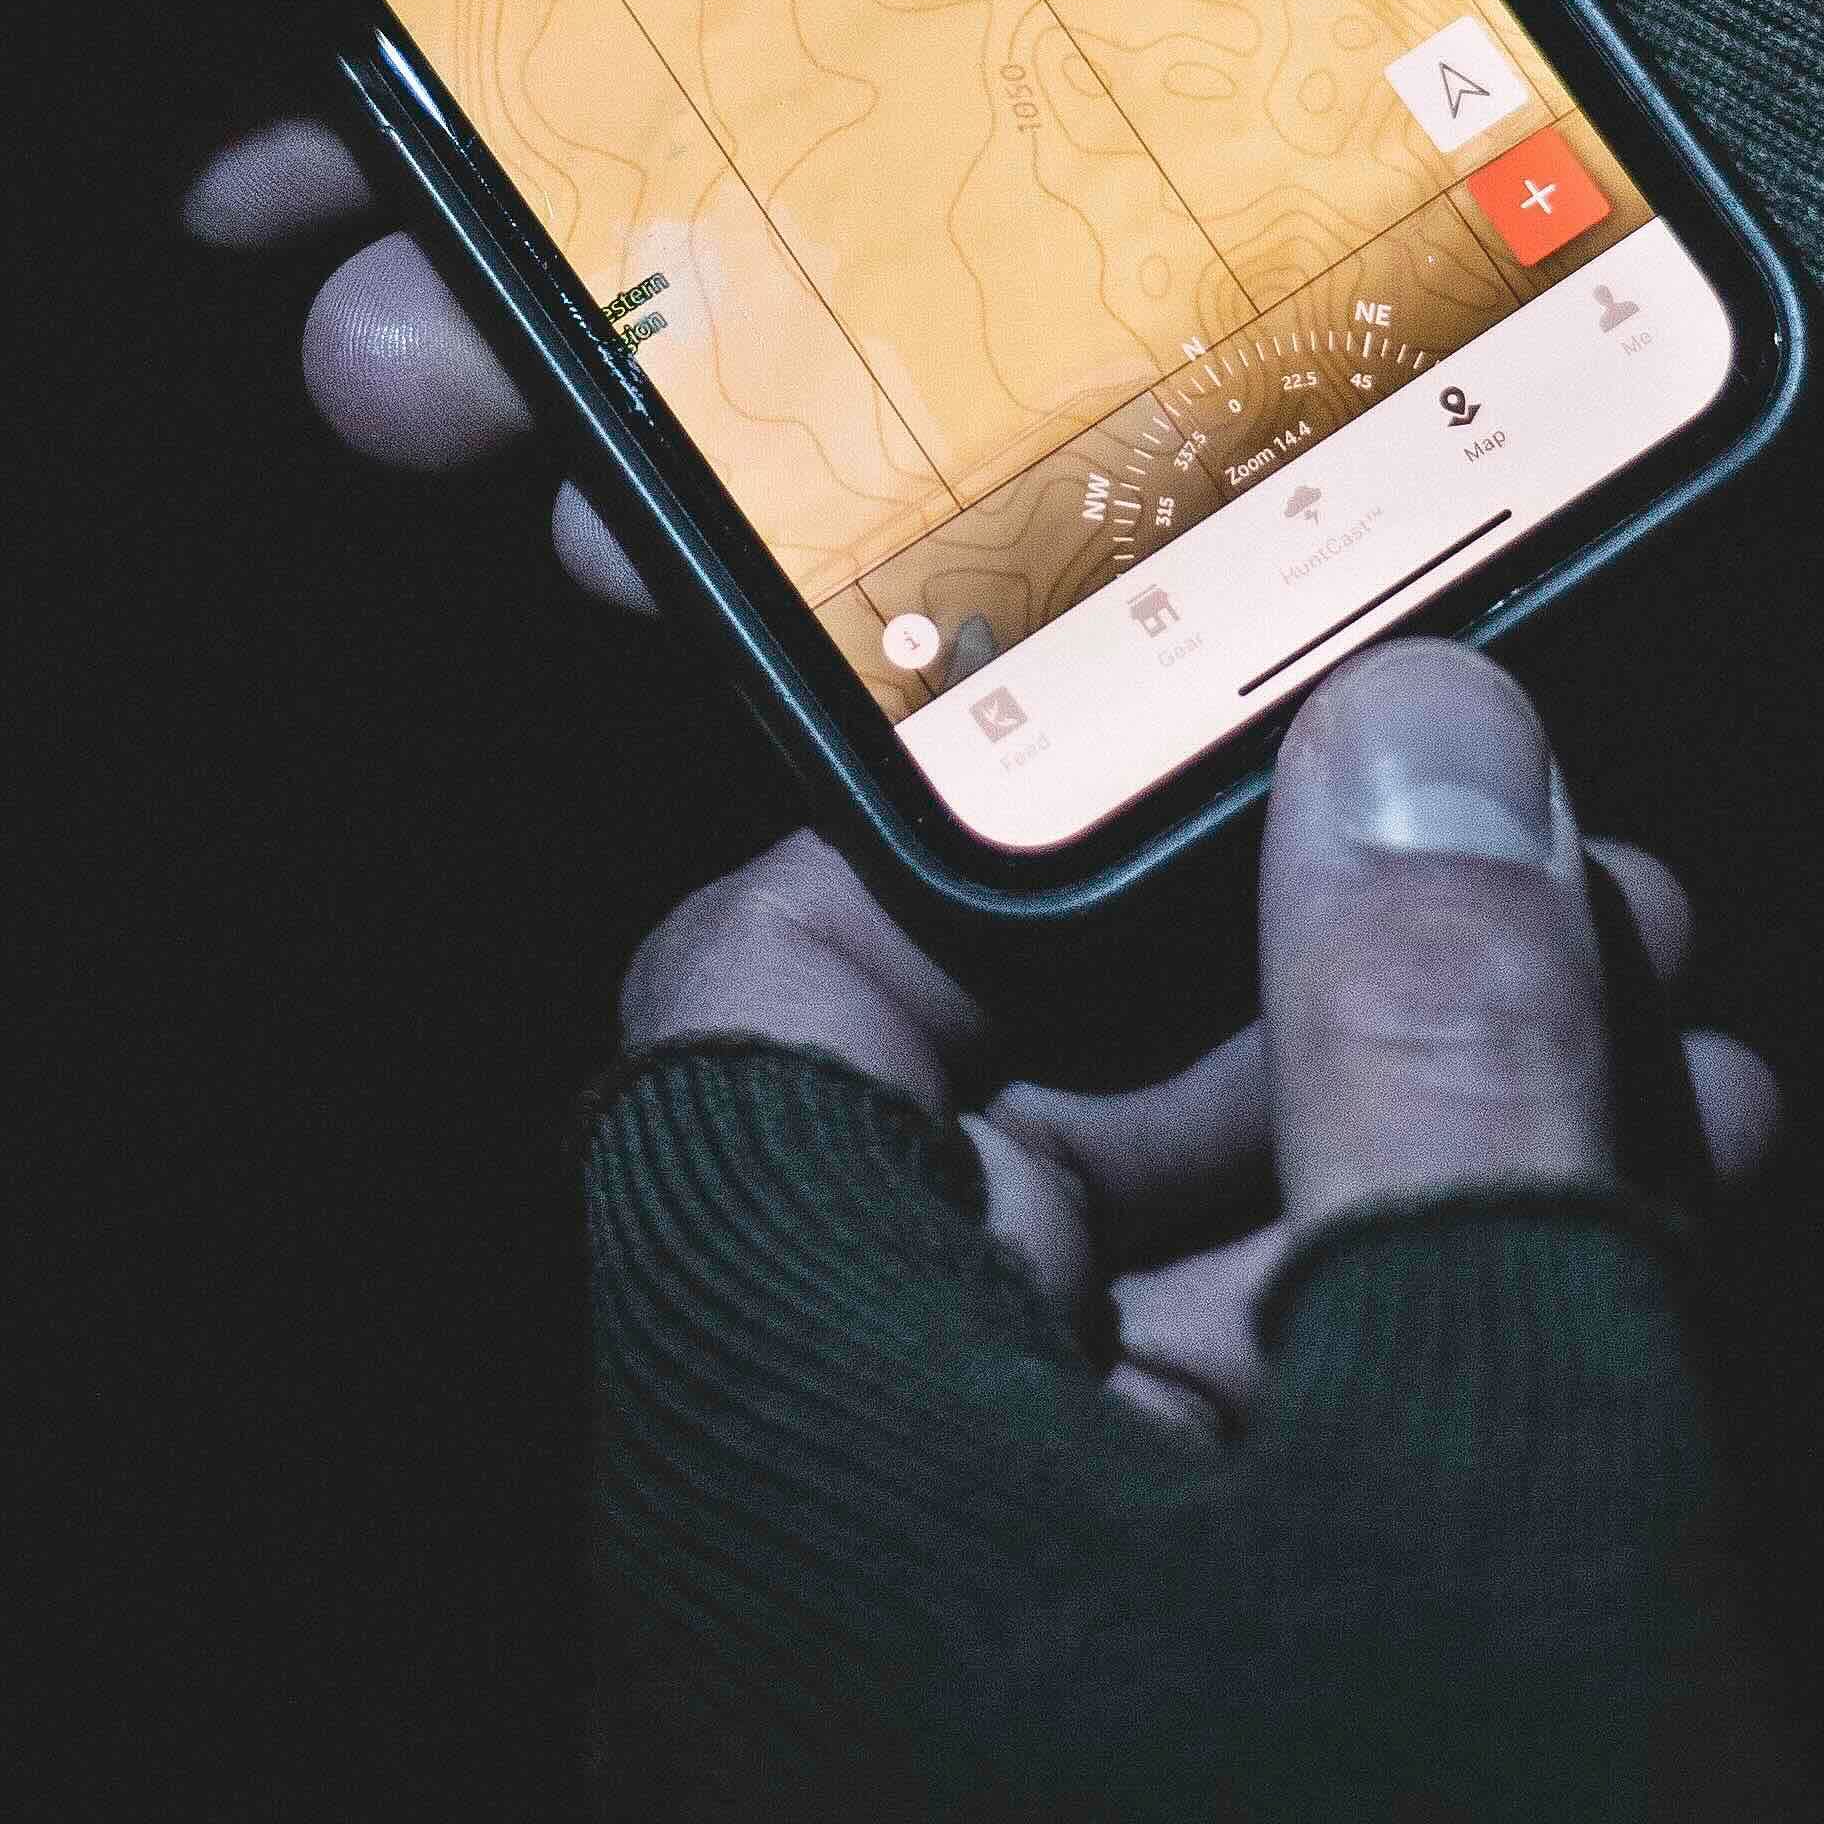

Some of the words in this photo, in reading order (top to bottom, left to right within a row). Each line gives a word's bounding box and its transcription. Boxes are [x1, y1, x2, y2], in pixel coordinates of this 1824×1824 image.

[1001, 64, 1040, 133] 1050
[600, 273, 670, 323] estern
[1354, 300, 1392, 326] NE
[1182, 336, 1207, 360] N
[1621, 329, 1654, 357] Me
[1281, 372, 1317, 390] 22.5
[1350, 373, 1373, 389] 45
[1228, 398, 1242, 414] 0
[1174, 431, 1208, 471] 337.5
[1224, 449, 1276, 486] Zoom
[1273, 420, 1311, 457] 14.4
[1463, 427, 1507, 464] Map
[1082, 473, 1110, 521] NW
[1155, 496, 1175, 526] 315
[1158, 633, 1203, 668] Gear
[1000, 732, 1051, 773] Feed
